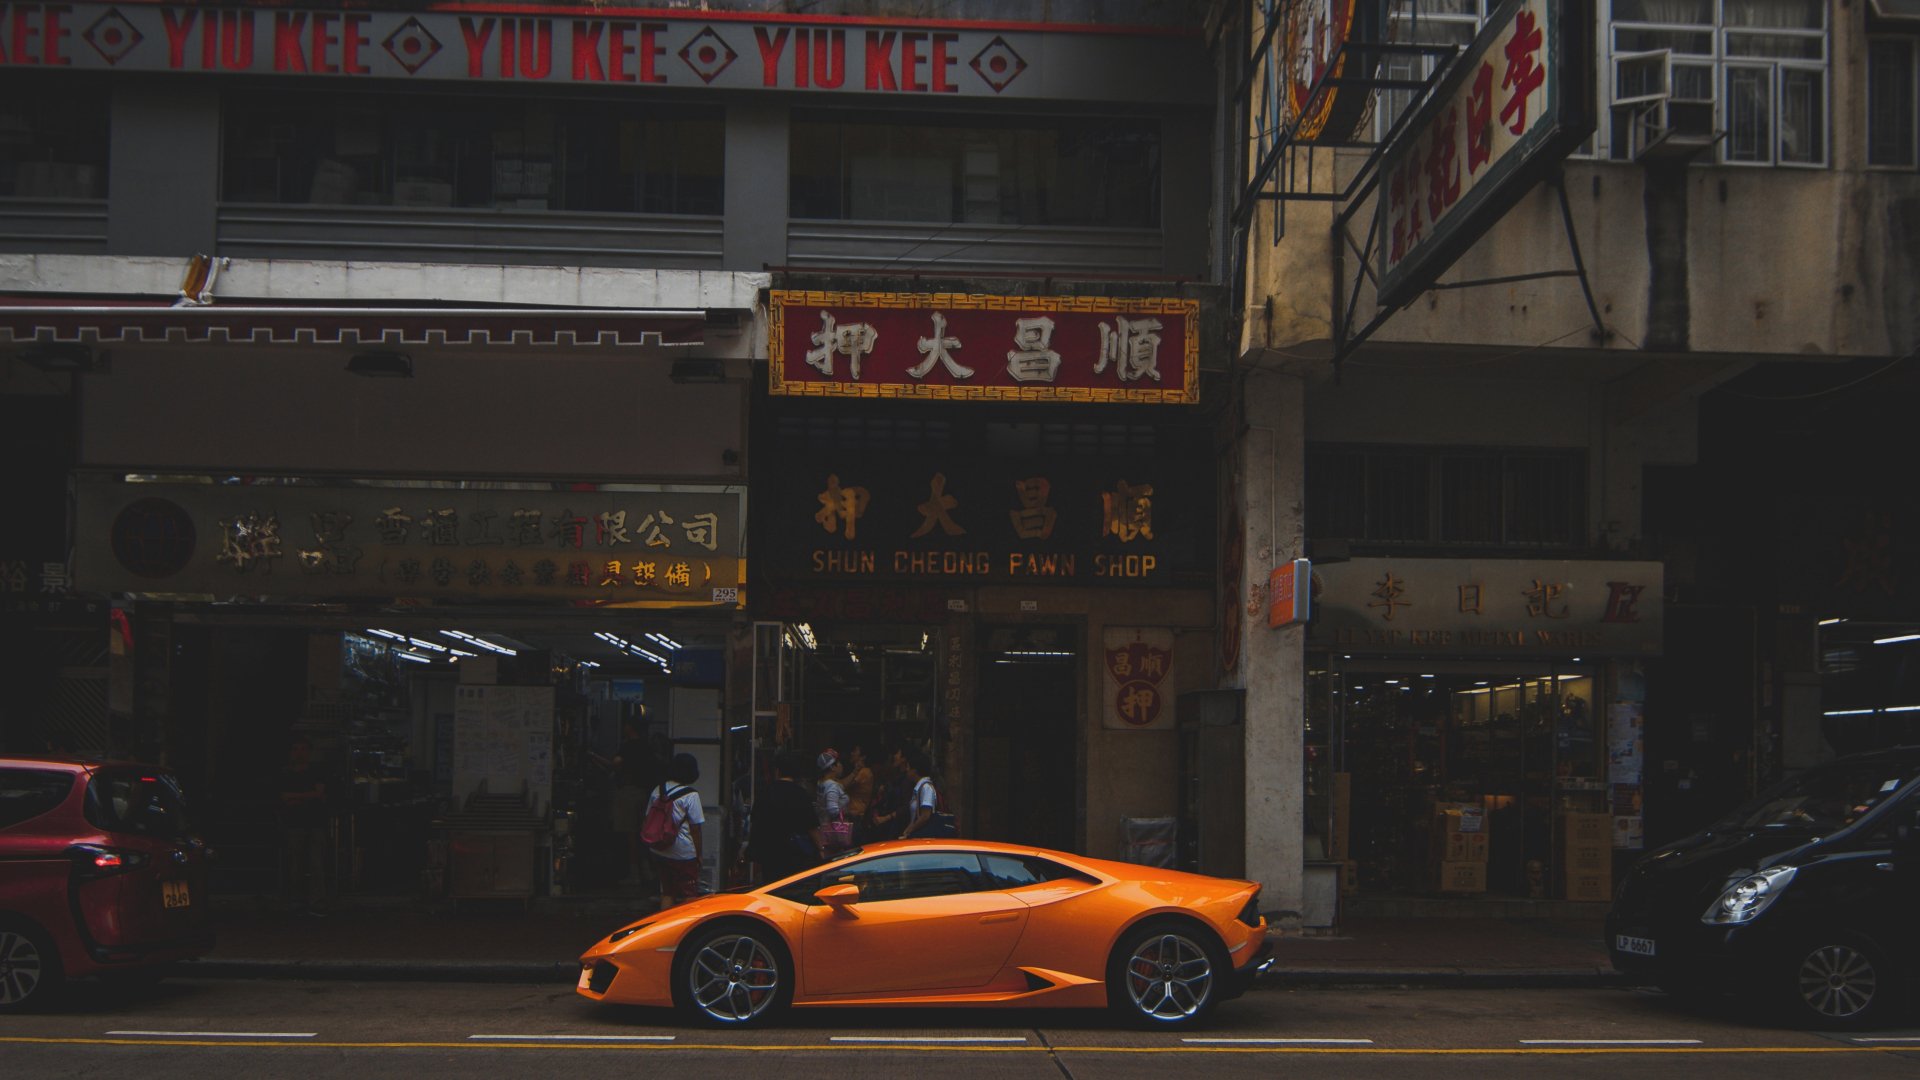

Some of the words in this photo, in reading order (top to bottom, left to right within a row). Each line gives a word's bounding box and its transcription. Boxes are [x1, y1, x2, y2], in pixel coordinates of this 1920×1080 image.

[0, 4, 71, 65] EE
[161, 6, 254, 71] YIU
[274, 12, 372, 75] KEE
[459, 17, 553, 79] YIU
[572, 20, 668, 83] KEE
[753, 26, 846, 89] YIU
[865, 31, 960, 93] KEE
[812, 551, 876, 576] SHUN
[893, 551, 990, 577] CHEONG
[1008, 552, 1076, 578] PAWN
[1094, 553, 1157, 579] SHOP
[715, 588, 737, 598] 295
[1618, 937, 1628, 950] LP
